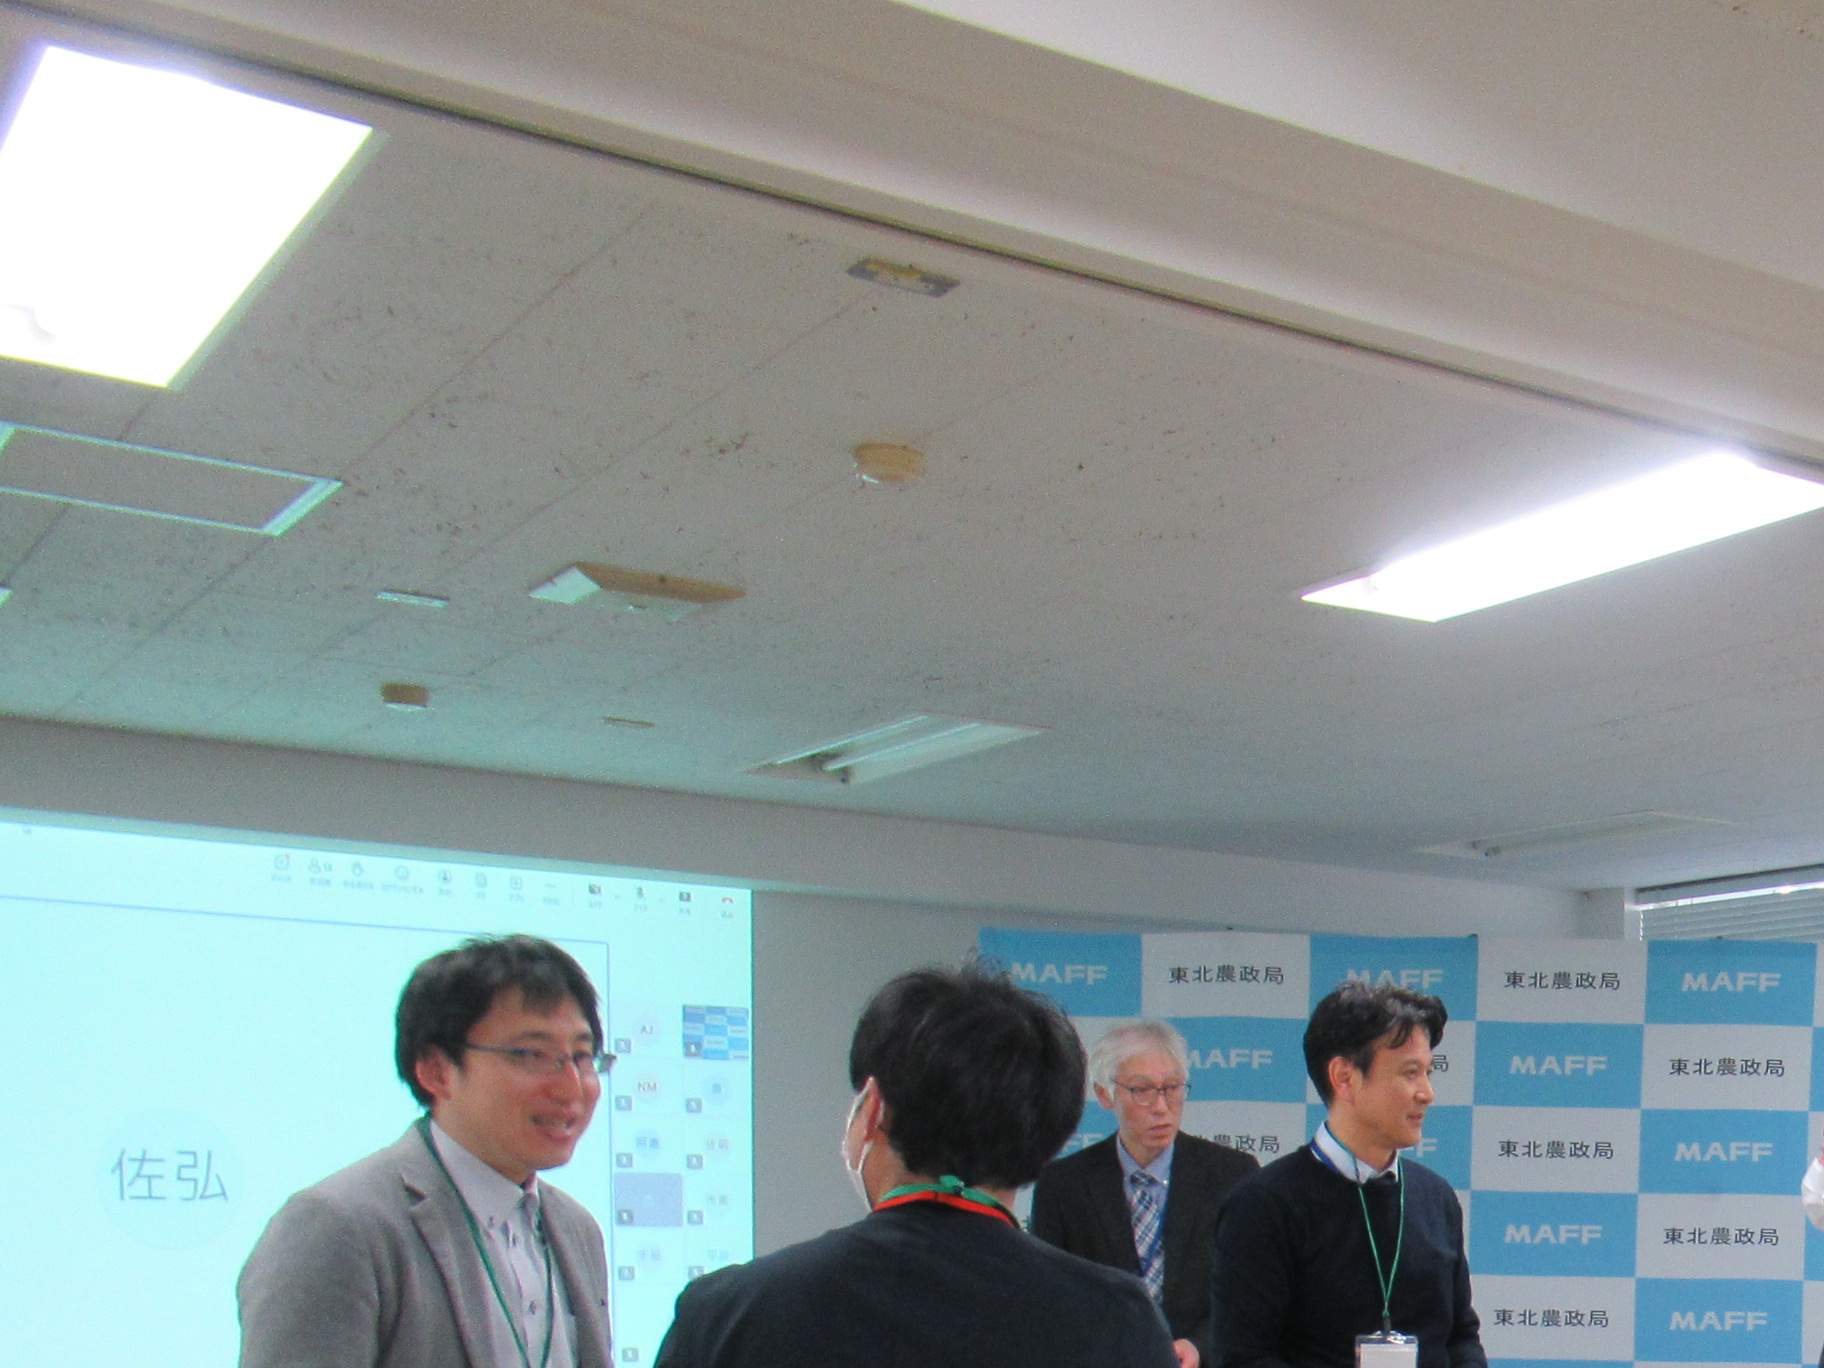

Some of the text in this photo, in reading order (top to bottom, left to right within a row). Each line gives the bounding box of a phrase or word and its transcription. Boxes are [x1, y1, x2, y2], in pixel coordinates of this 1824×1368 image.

[1009, 962, 1109, 986] MAFF
[1168, 964, 1285, 986] 東北農政局
[1504, 971, 1621, 991] 東北農政局
[1681, 971, 1781, 993] MAFF
[1509, 1055, 1609, 1076] MAFF
[1669, 1057, 1786, 1078] 東北農政局
[1498, 1139, 1615, 1160] 東北農政局
[1674, 1141, 1774, 1162] MAFF
[110, 1148, 230, 1202] 佐弘
[1504, 1224, 1603, 1245] MAFF
[1662, 1227, 1780, 1247] 東北農政局
[1494, 1308, 1610, 1329] 東北農政局
[1669, 1311, 1768, 1332] MAFF
